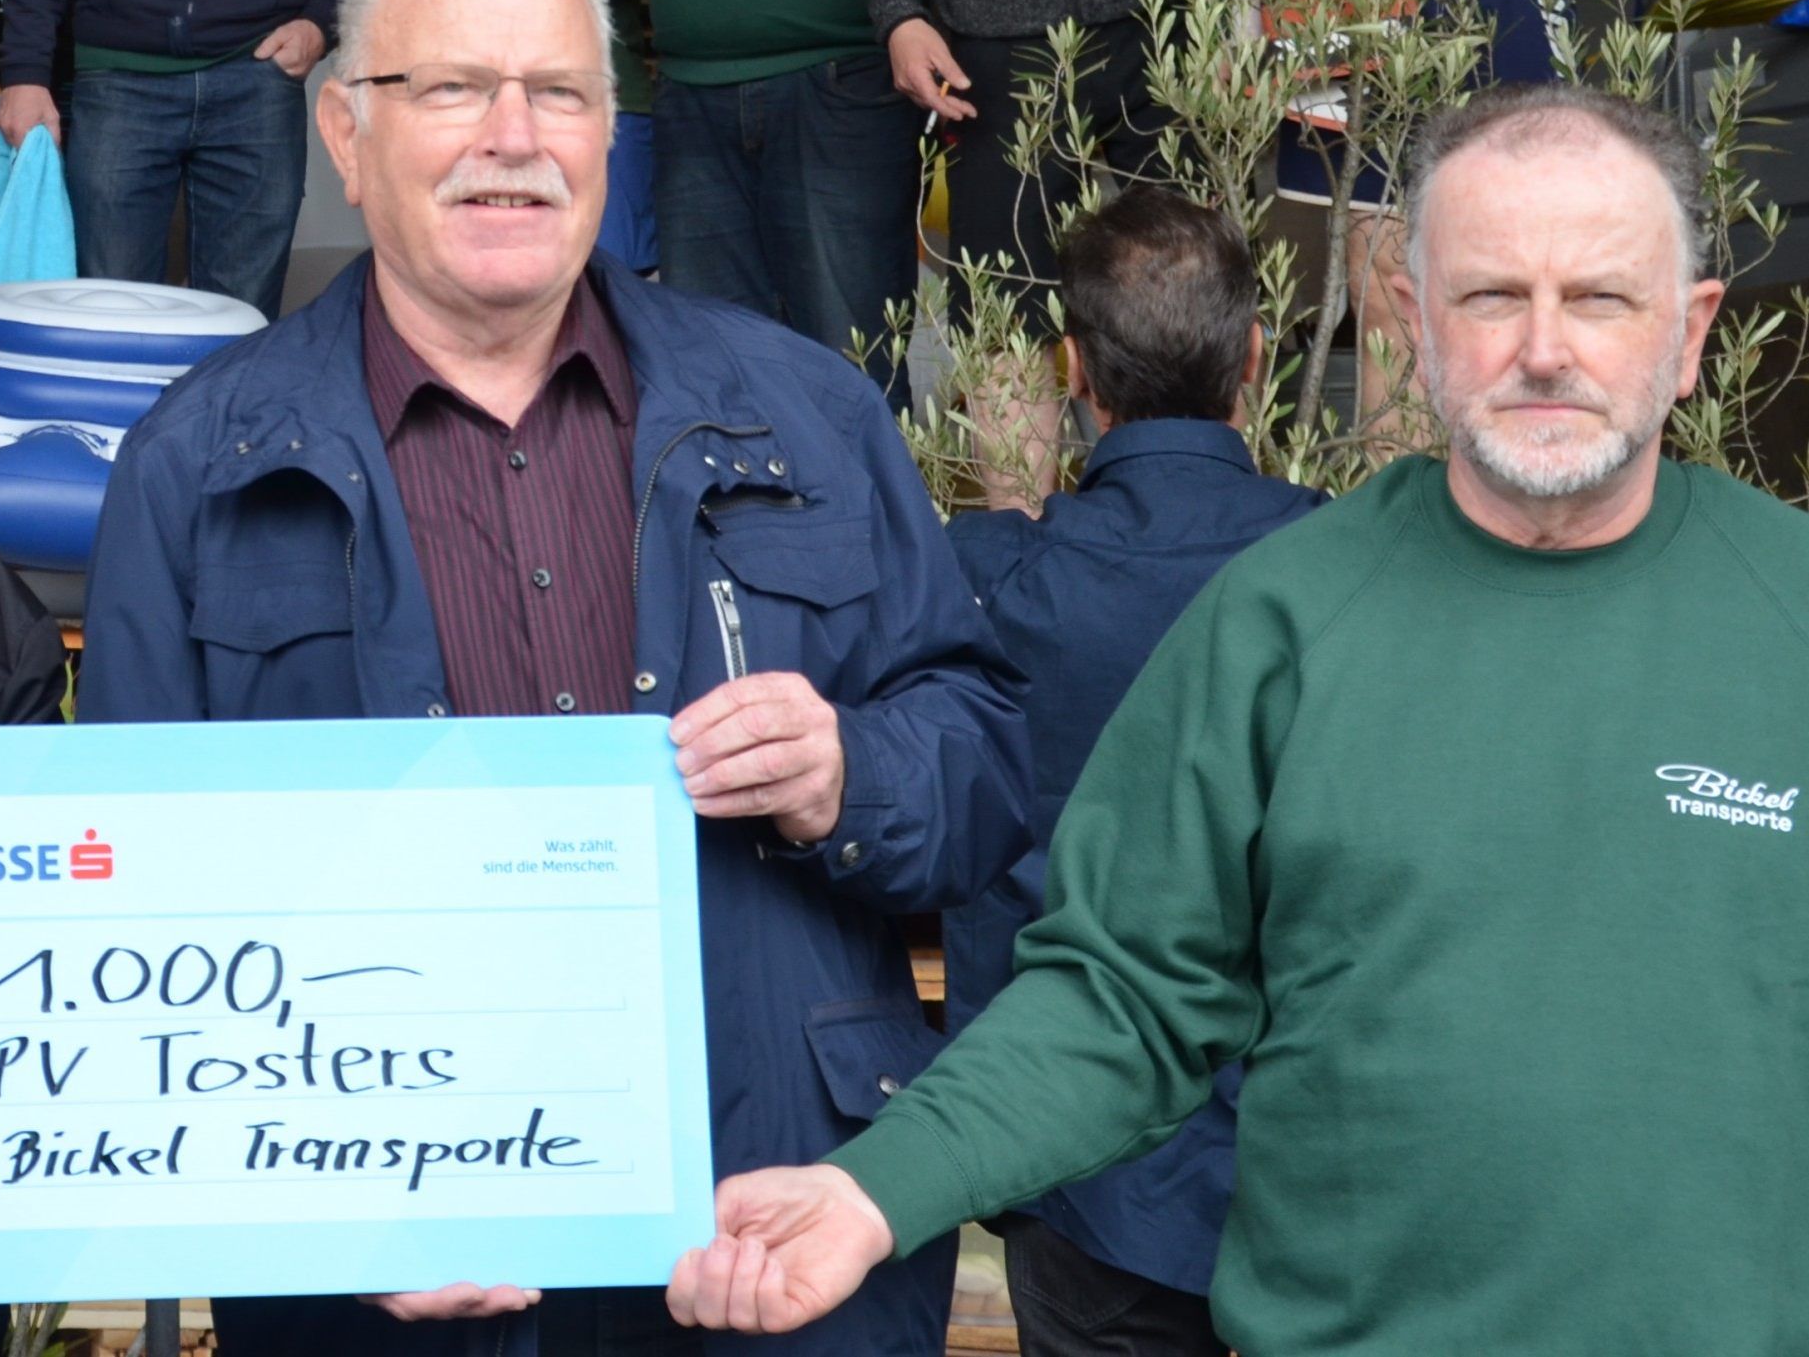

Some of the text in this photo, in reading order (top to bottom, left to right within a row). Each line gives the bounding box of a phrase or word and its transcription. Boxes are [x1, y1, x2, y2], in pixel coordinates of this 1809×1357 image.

[1655, 763, 1800, 811] Bickel
[1665, 795, 1793, 832] Transporte
[483, 859, 619, 874] sind die Menschen.
[544, 840, 575, 853] Was
[140, 1022, 458, 1095] Tosters
[2, 1107, 599, 1192] Bickel Transporte
